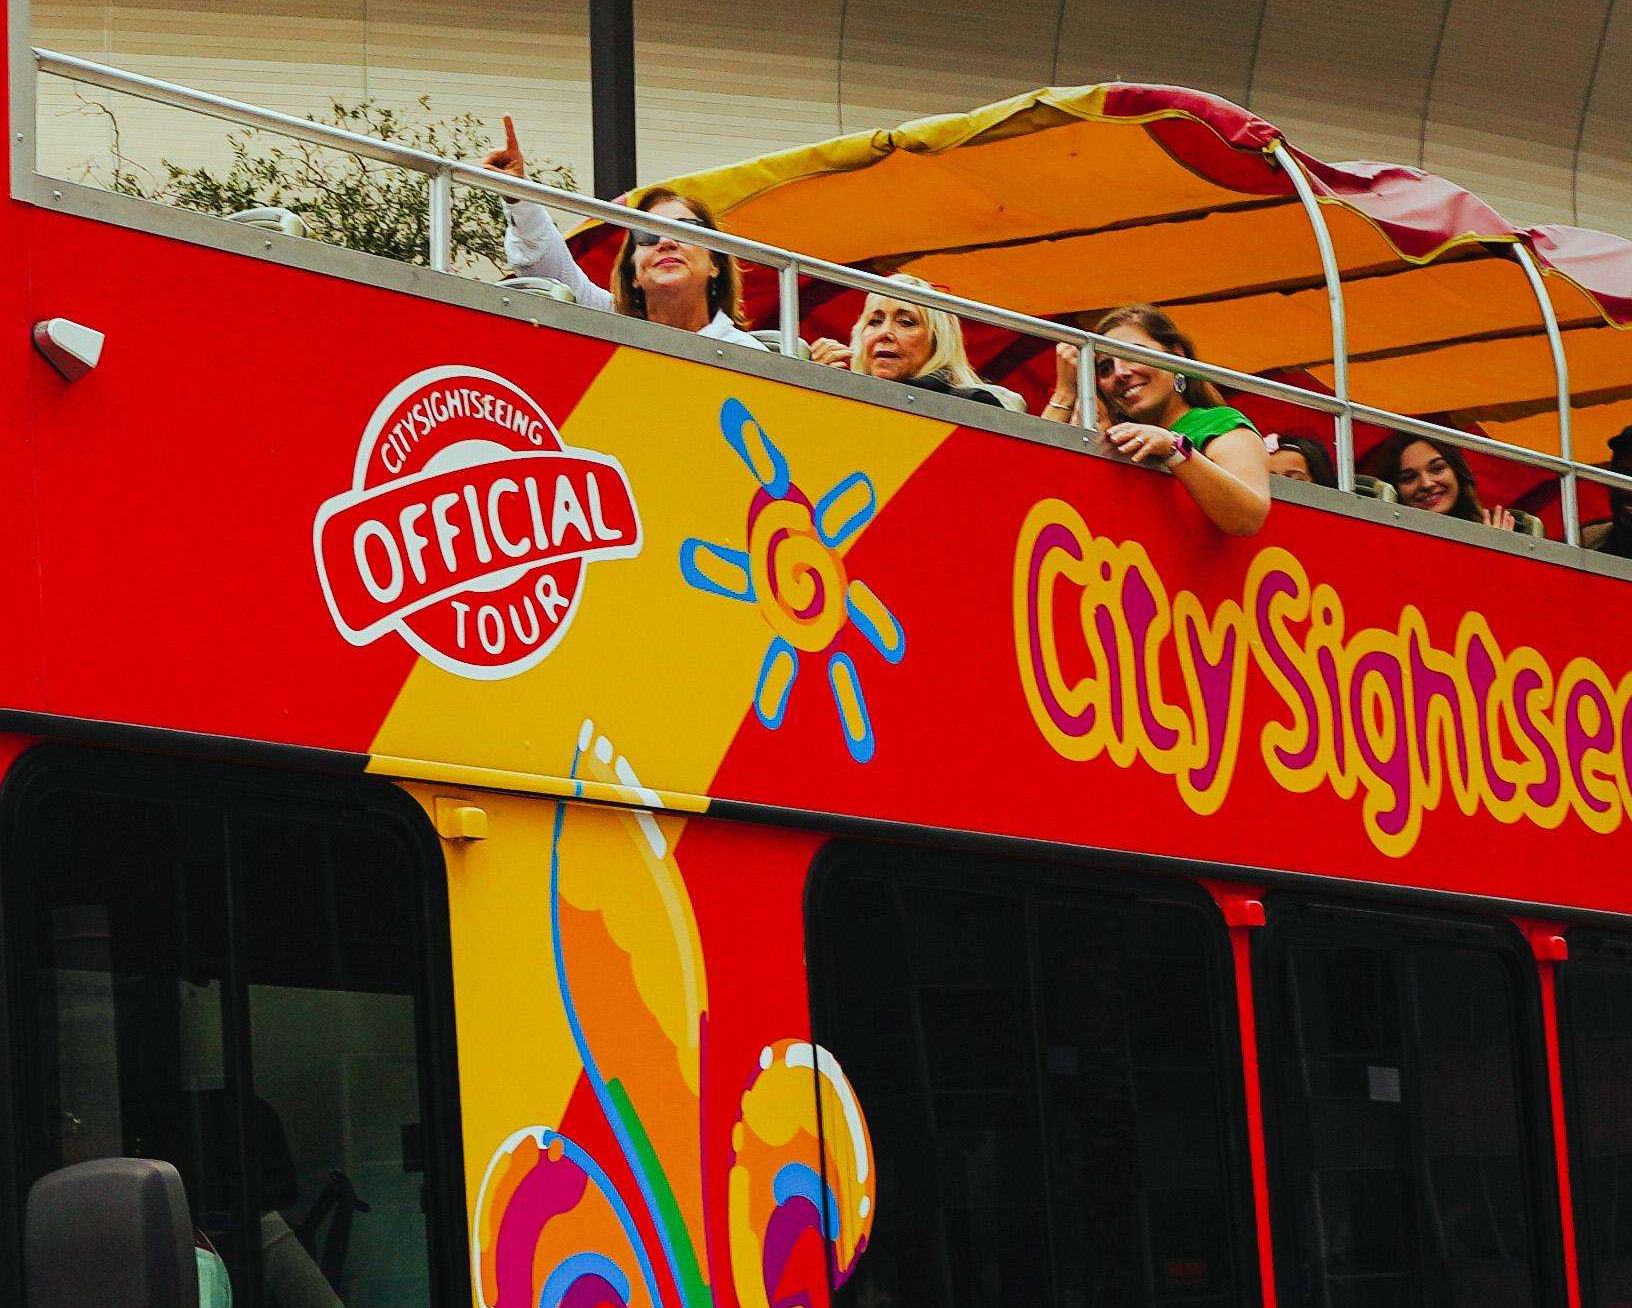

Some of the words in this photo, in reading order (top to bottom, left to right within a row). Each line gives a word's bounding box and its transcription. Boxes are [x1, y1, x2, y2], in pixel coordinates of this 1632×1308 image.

[380, 389, 543, 474] CITYSIGHTSEEING
[353, 472, 622, 603] OFFICIAL
[451, 574, 569, 655] TOUR
